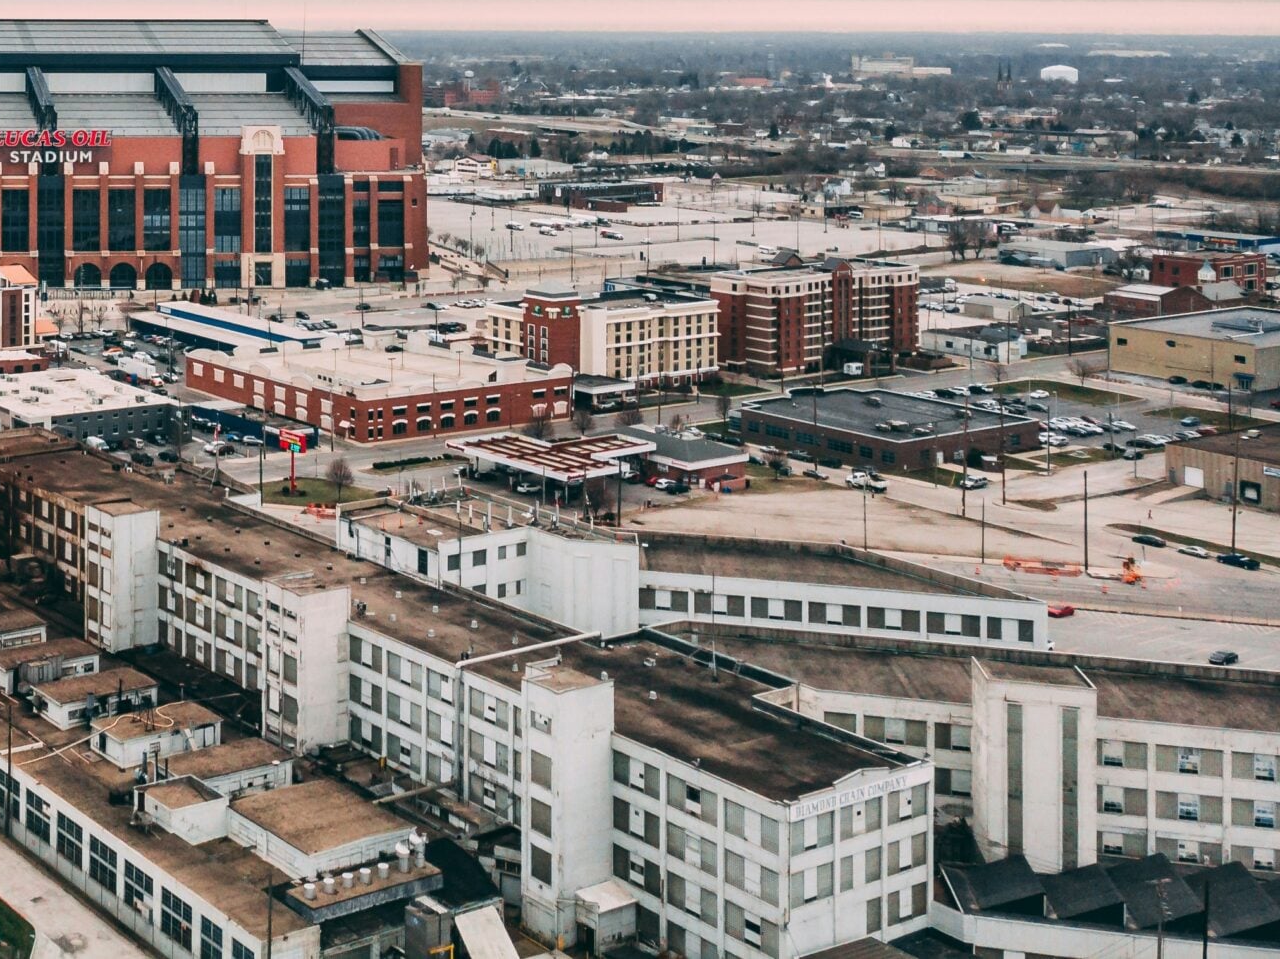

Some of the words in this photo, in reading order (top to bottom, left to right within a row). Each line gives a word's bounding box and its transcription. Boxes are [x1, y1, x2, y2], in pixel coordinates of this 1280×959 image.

[72, 129, 112, 147] OIL
[10, 150, 93, 164] STADIUM
[795, 796, 837, 818] DIAMOND
[839, 787, 865, 806] CHAIN
[867, 775, 908, 797] COMPANY
